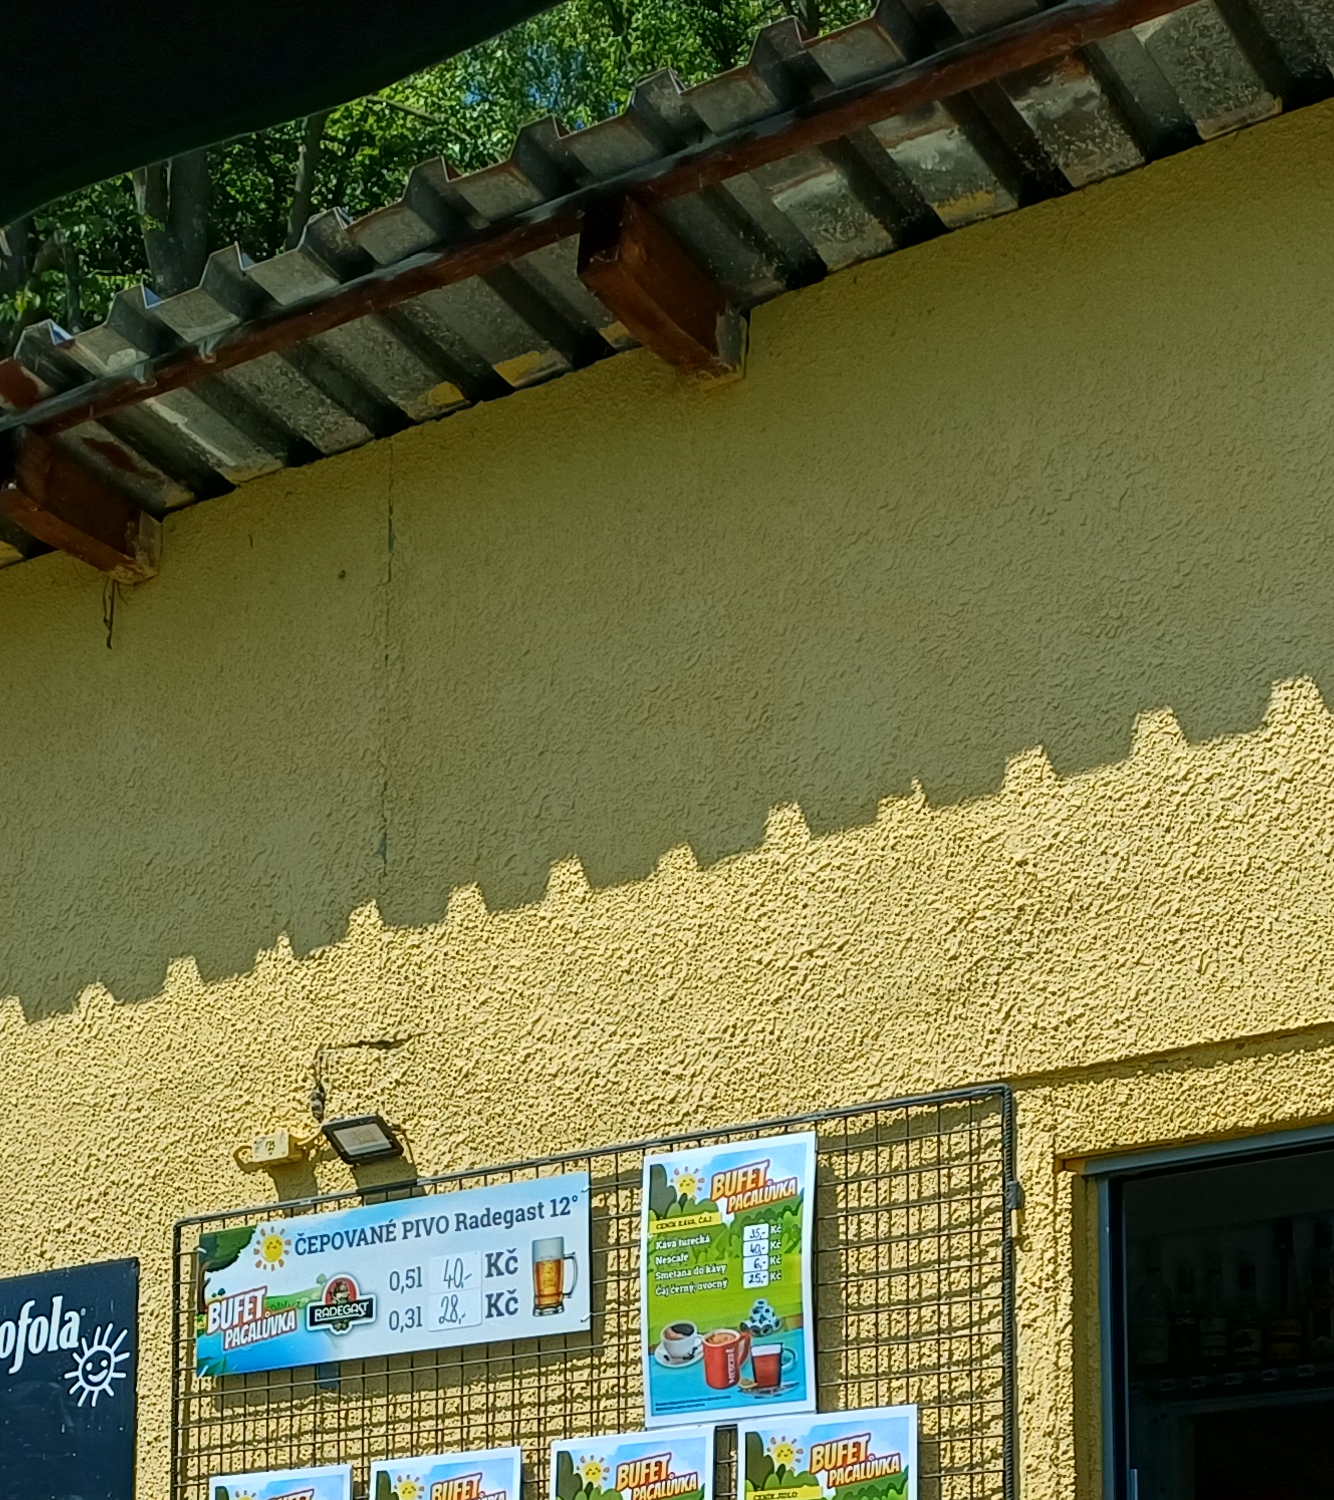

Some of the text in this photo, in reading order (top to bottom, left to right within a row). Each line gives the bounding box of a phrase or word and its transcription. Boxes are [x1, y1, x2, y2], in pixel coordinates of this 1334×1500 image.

[711, 1160, 769, 1200] BUFET
[728, 1178, 798, 1213] PACALŮVKA
[295, 1195, 579, 1256] ČEPOVANÉ PIVO Radegast 12°
[770, 1224, 782, 1233] Kč
[389, 1266, 423, 1293] 0,5l
[485, 1247, 518, 1278] Kč
[655, 1269, 692, 1280] Smetana
[693, 1267, 703, 1275] do
[207, 1287, 266, 1334] BUFET
[314, 1301, 370, 1322] RADEGAST
[389, 1306, 423, 1333] 0,3l
[485, 1288, 519, 1319] Kč
[224, 1310, 296, 1349] PACALŮVKA
[810, 1434, 870, 1474] BUFET
[827, 1454, 901, 1488] PACALŮVKA
[616, 1454, 671, 1492] BUFET
